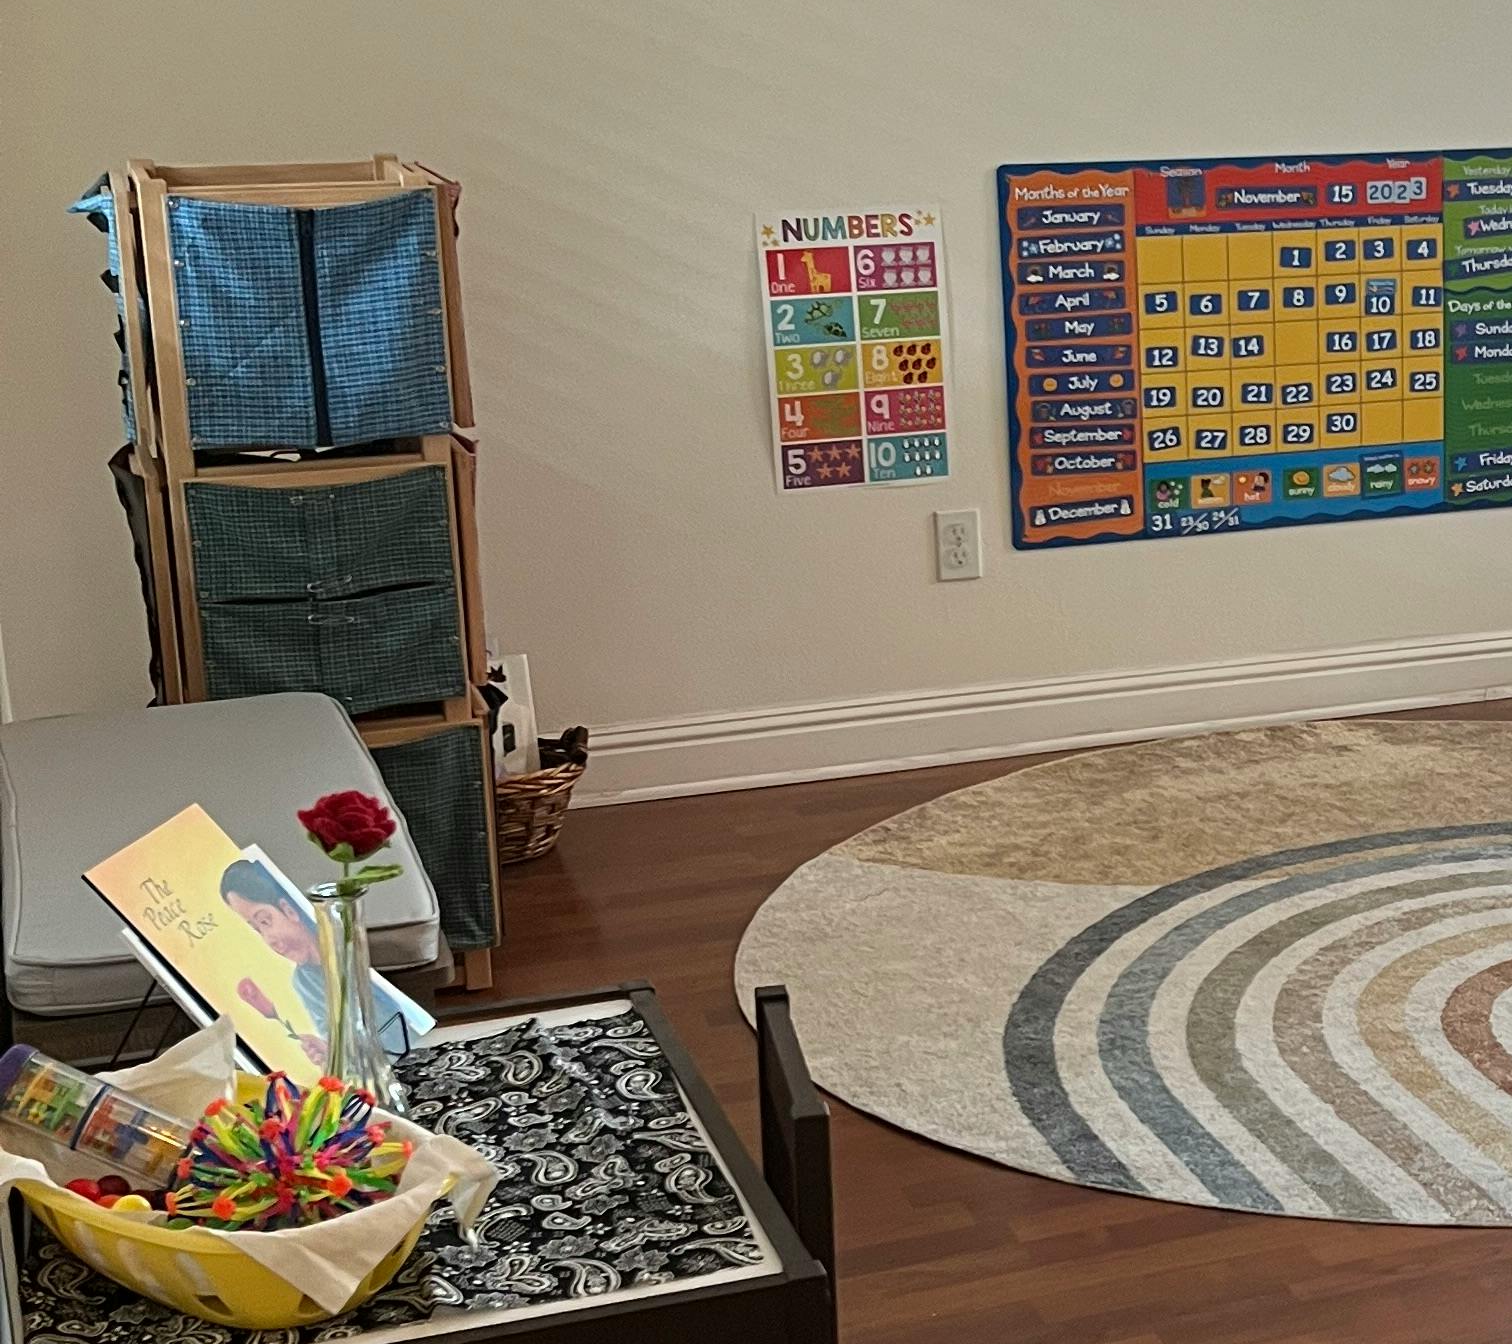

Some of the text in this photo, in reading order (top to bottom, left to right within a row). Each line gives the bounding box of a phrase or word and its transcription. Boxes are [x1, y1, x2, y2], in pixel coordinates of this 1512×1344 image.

[1275, 162, 1310, 173] Month
[1386, 158, 1410, 168] Year
[1463, 166, 1510, 176] Yesterday
[1160, 166, 1202, 178] Season
[1015, 184, 1129, 200] Months of the Year
[1234, 180, 1423, 203] November 15 2023
[1042, 211, 1100, 224] January
[1479, 206, 1507, 214] Today
[782, 213, 913, 242] NUMBERS
[1145, 227, 1175, 235] Sunday
[1190, 224, 1221, 232] Monday
[1236, 223, 1266, 231] Tuesday
[1368, 217, 1391, 225] Friday
[1039, 239, 1104, 254] February
[1292, 241, 1428, 266] 1 2 3 4
[777, 253, 786, 280] 1
[857, 249, 875, 275] 6
[1049, 263, 1094, 278] March
[772, 282, 795, 293] One
[858, 277, 876, 288] Six
[1055, 293, 1089, 311] April
[1155, 286, 1435, 313] 5 6 7 8 9 10 11
[1449, 301, 1480, 314] Days
[1483, 302, 1494, 311] of
[1496, 299, 1511, 309] the
[776, 304, 795, 330] 2
[870, 299, 886, 324] 7
[862, 327, 899, 338] Seven
[1064, 322, 1094, 336] May
[776, 333, 800, 343] Two
[1062, 350, 1097, 363] June
[1152, 331, 1435, 366] 12 13 14 16 17 18
[872, 345, 888, 370] 8
[787, 354, 804, 380] 3
[1068, 376, 1098, 391] July
[1150, 372, 1436, 406] 19 20 21 22 23 24 25
[784, 401, 804, 426] 4
[871, 394, 890, 419] 9
[1060, 404, 1112, 420] August
[782, 428, 809, 438] Four
[868, 421, 895, 432] Nine
[1152, 415, 1354, 448] 26 27 28 29 30
[1044, 429, 1122, 445] September
[788, 450, 806, 474] 5
[870, 442, 896, 468] 10
[1055, 458, 1115, 469] October
[786, 475, 811, 486] Five
[874, 468, 896, 479] Ten
[1408, 477, 1435, 486] snowy
[1048, 482, 1120, 496] November
[1289, 487, 1315, 495] sunny
[1370, 480, 1393, 489] rainy
[1049, 503, 1118, 520] December
[1158, 499, 1179, 508] cold
[1152, 507, 1239, 535] 31 23/30 24/31
[140, 877, 173, 904] The
[143, 899, 187, 930] Peace
[178, 913, 219, 947] Rose
